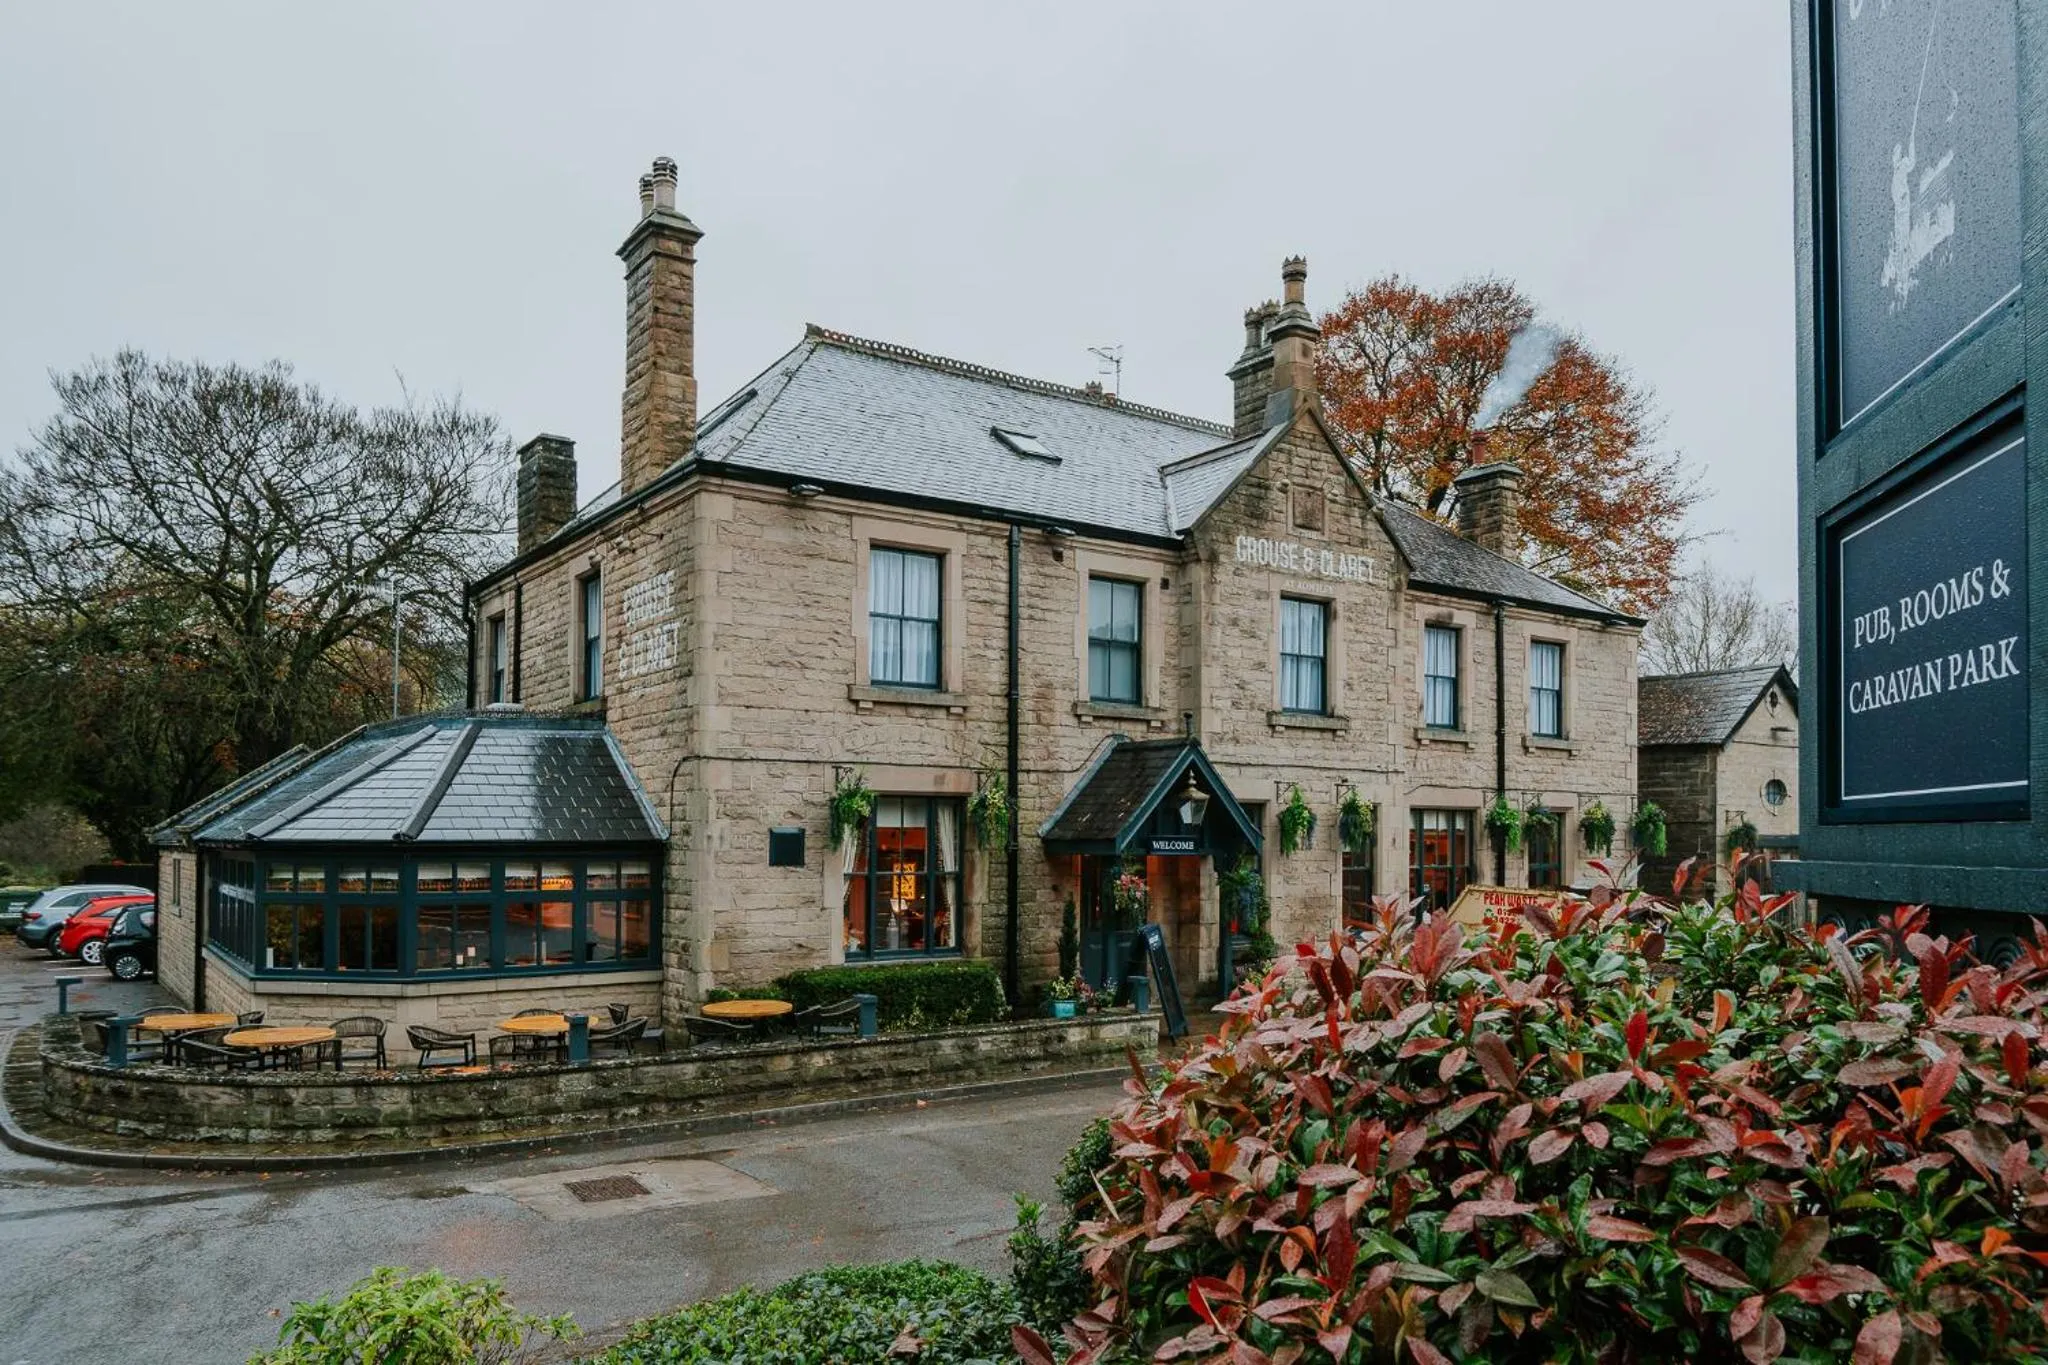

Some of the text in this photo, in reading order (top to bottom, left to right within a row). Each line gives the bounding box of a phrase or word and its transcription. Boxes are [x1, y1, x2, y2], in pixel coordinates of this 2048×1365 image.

[1236, 535, 1375, 582] GROUSE & CLARET
[1853, 558, 2012, 648] PUB, ROOMS &
[1849, 636, 2021, 714] CARAVAN PARK
[1152, 840, 1195, 850] WELCOME
